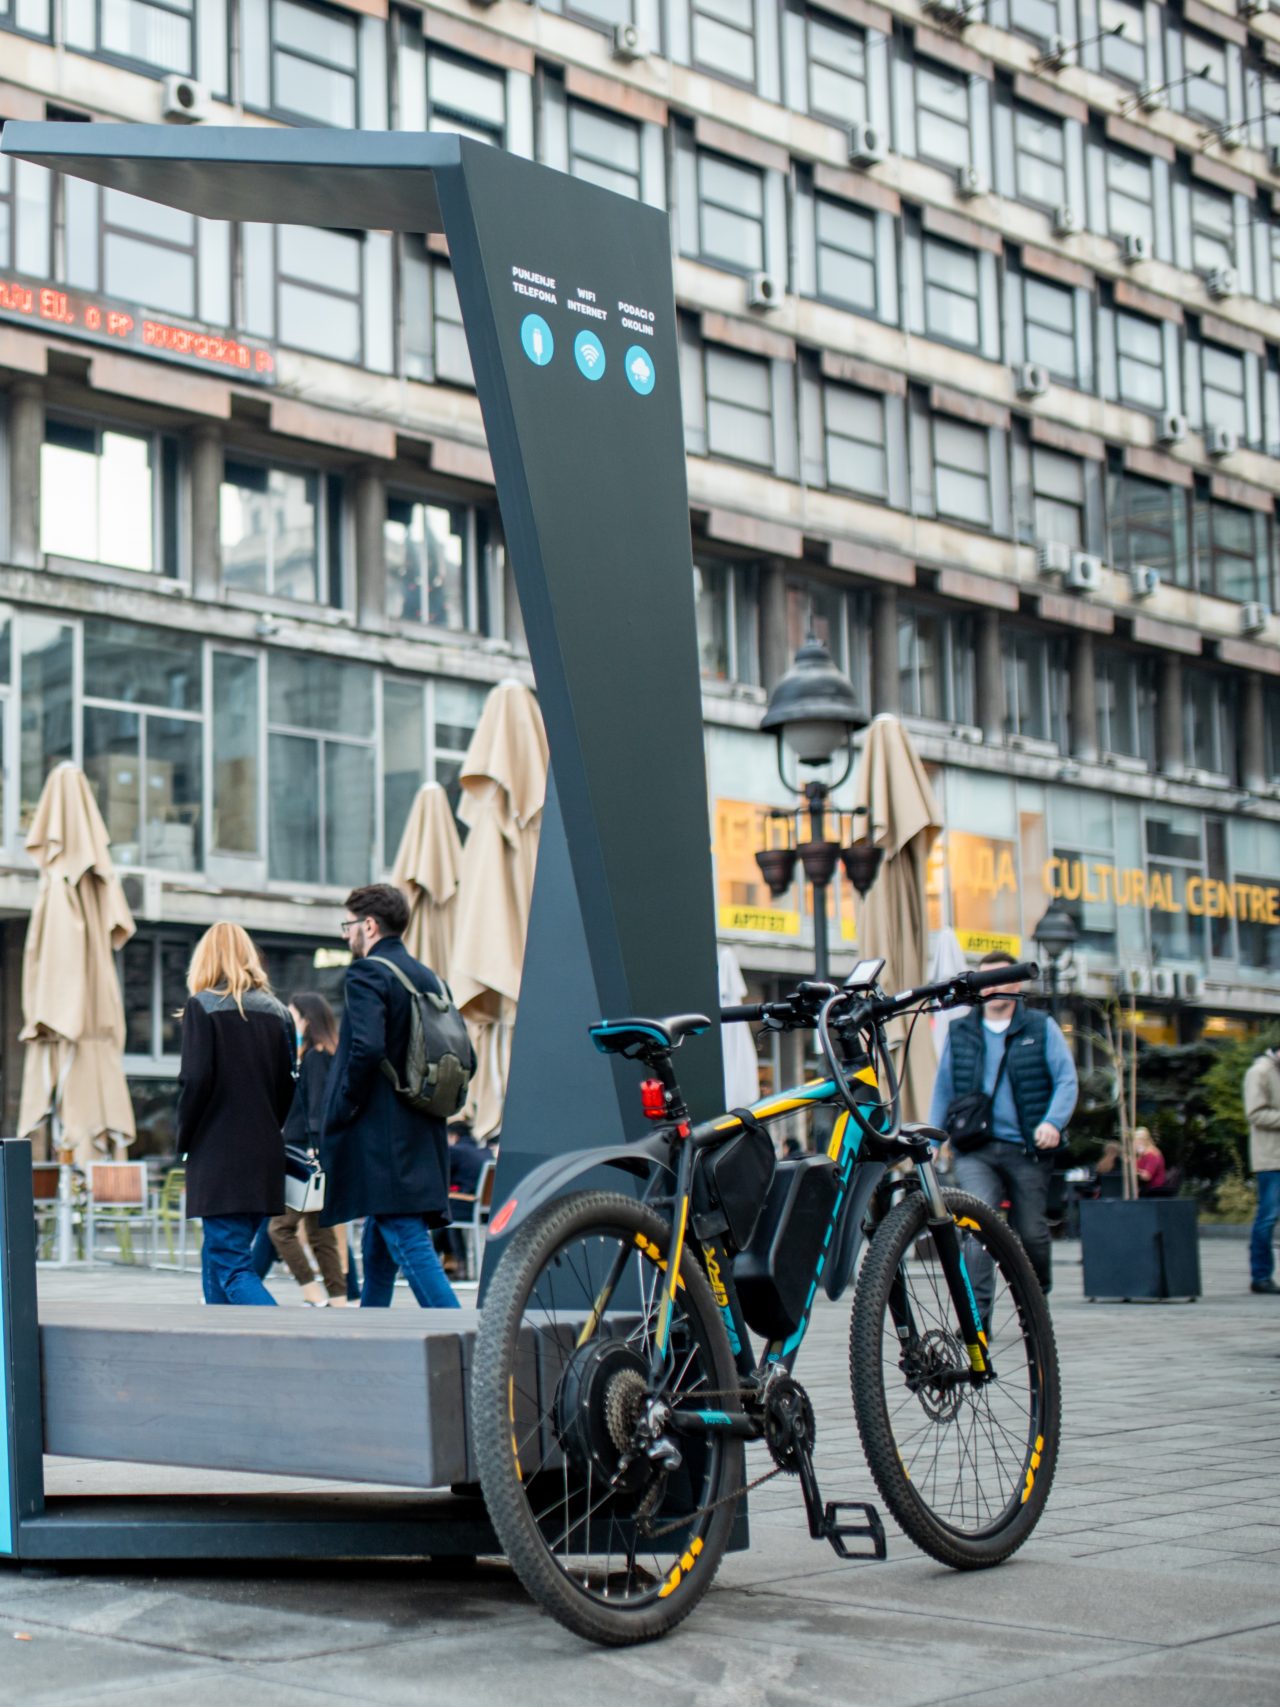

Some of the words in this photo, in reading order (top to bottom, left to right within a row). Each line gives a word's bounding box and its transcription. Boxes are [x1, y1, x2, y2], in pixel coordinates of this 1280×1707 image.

[512, 266, 556, 289] PUNJENJE
[512, 282, 557, 305] TELEFONA
[577, 288, 596, 302] WIFI
[567, 300, 608, 321] INTERNET
[618, 301, 648, 319] PODACI
[647, 311, 655, 322] O
[622, 317, 654, 337] OKOLINI
[1041, 856, 1182, 913] CULTURAL
[1185, 874, 1280, 926] CENTRE
